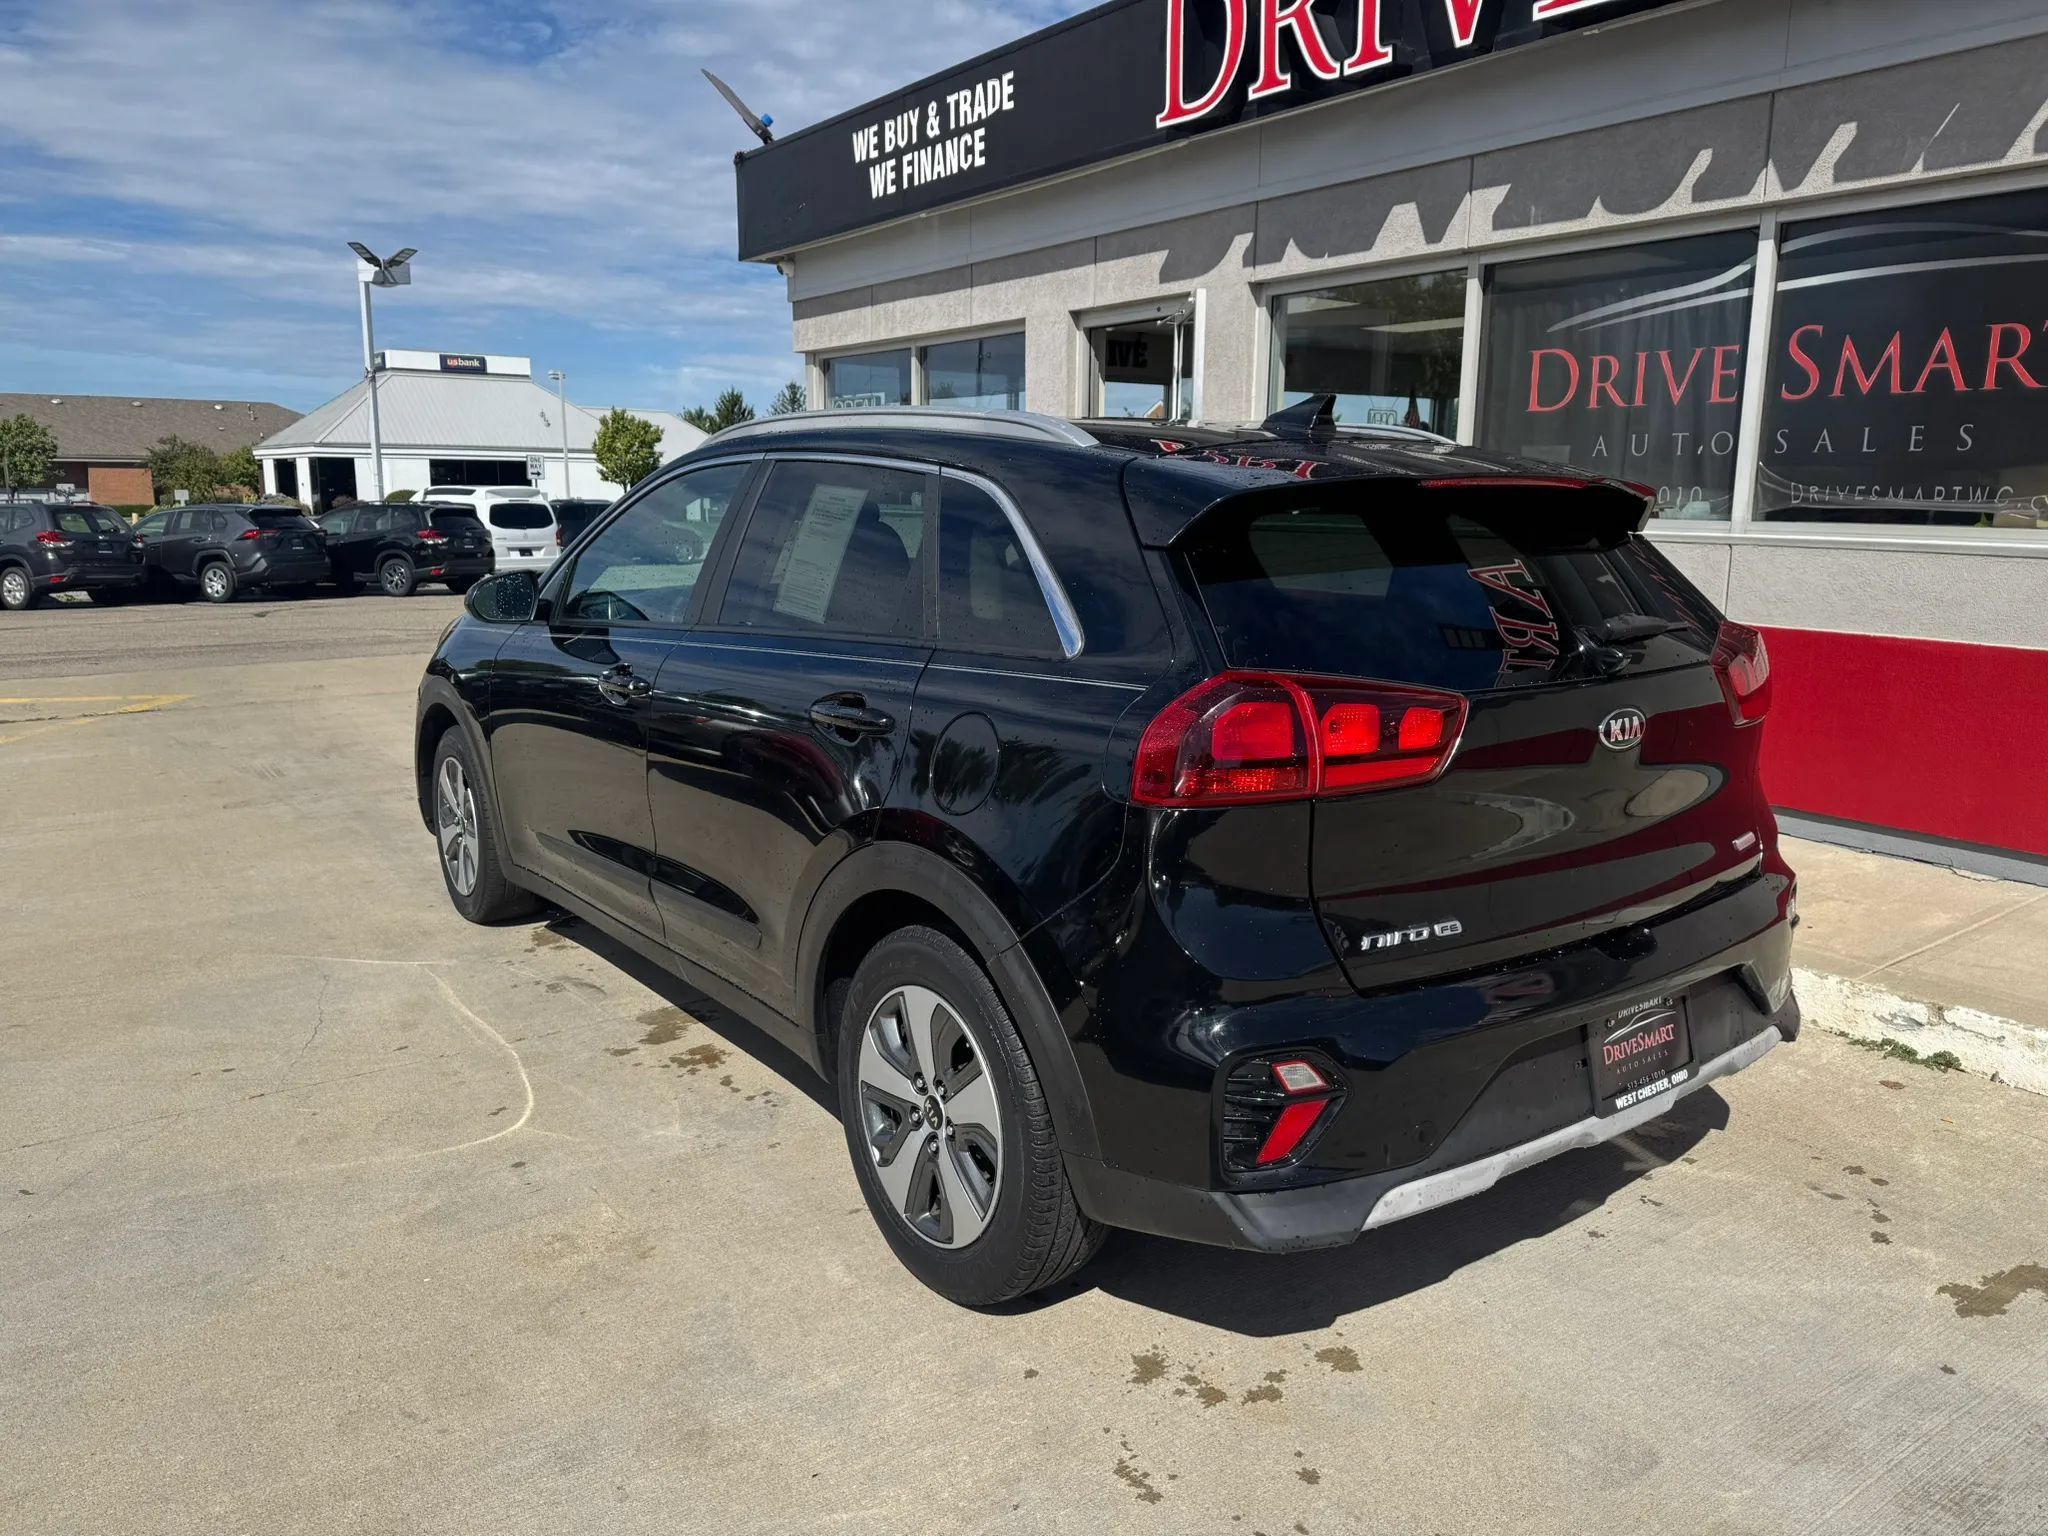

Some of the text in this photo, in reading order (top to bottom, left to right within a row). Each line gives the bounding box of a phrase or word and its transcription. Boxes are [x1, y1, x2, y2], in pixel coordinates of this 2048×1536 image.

[852, 70, 1015, 164] WE BUY & TRADE
[869, 127, 986, 200] WE FINANCE
[446, 355, 481, 368] usbank
[1526, 320, 2048, 413] DRIVE SMAR
[1592, 423, 1974, 457] AUTO SALES
[1609, 715, 1641, 742] KIA
[1437, 922, 1461, 935] FE
[1616, 1049, 1669, 1075] AUTO SALES
[1615, 1068, 1688, 1110] WEST CHESTER, OHIO
[924, 1100, 938, 1128] KIA
